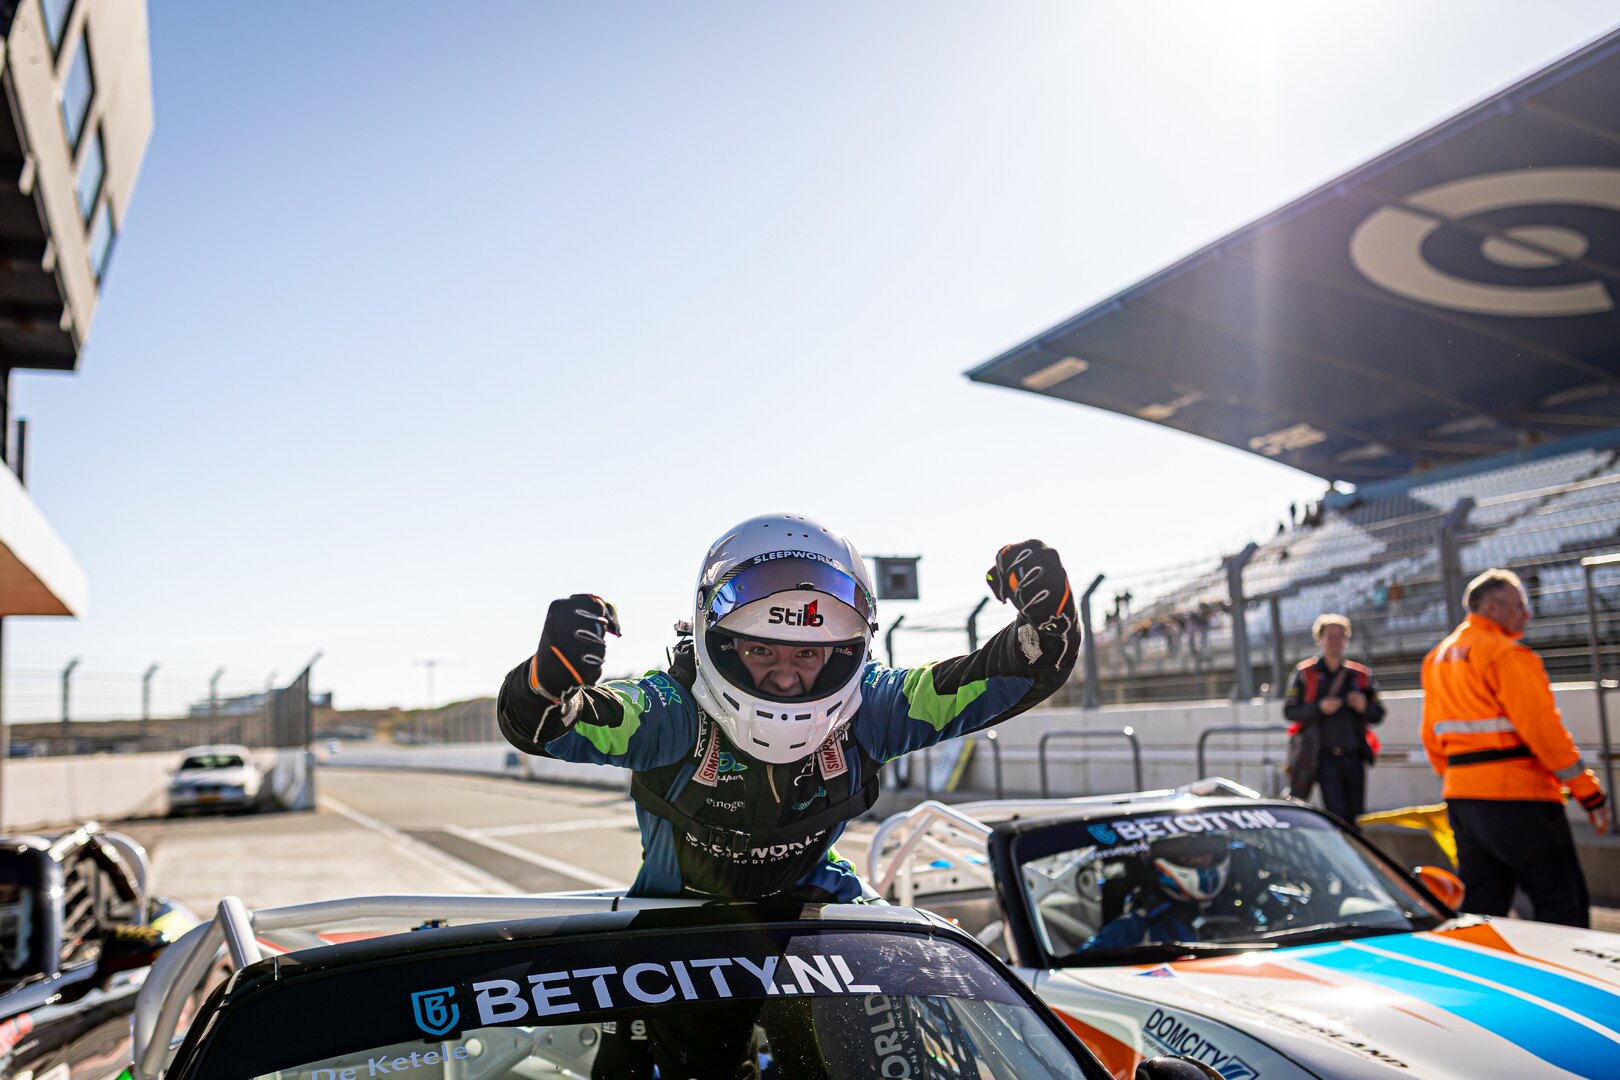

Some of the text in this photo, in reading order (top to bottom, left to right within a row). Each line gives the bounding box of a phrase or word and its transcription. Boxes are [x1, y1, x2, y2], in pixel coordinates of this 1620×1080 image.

[768, 599, 824, 627] Stilo
[472, 955, 881, 1025] BETCITY.NL
[368, 1043, 470, 1077] Ketele
[1146, 1008, 1229, 1067] DOMCITY
